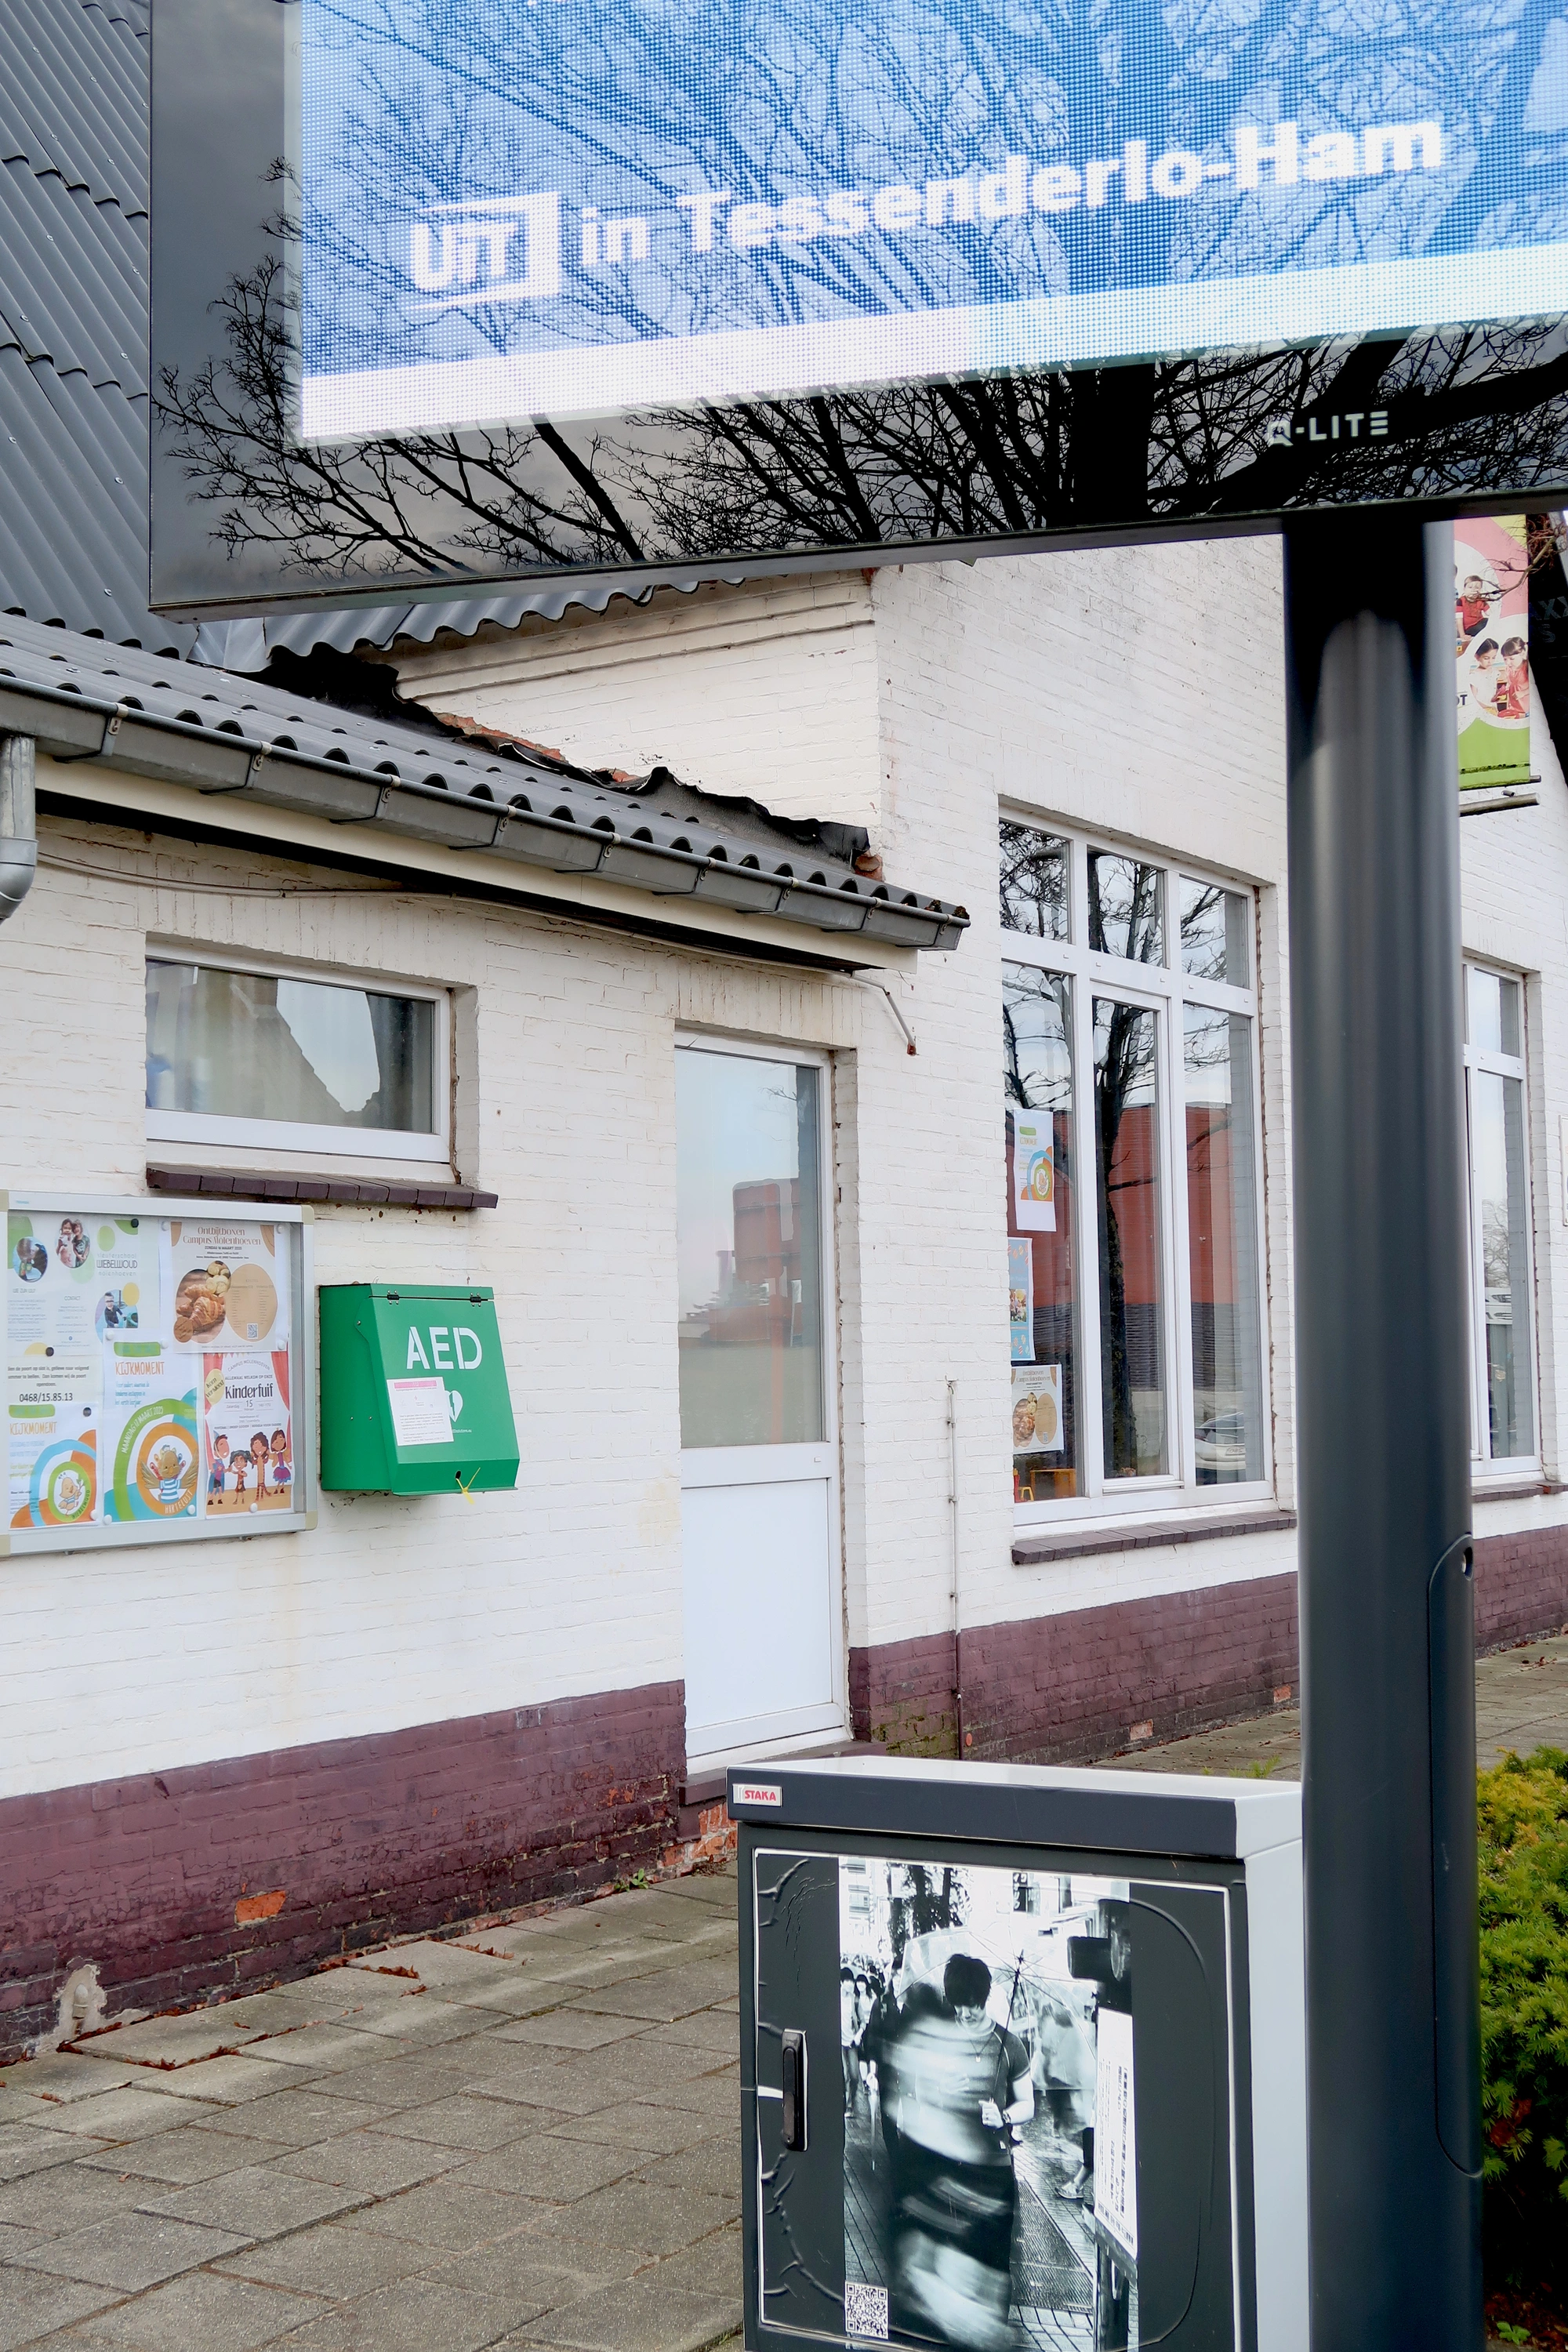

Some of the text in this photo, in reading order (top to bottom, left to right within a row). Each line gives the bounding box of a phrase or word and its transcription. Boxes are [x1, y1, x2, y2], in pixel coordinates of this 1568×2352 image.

[582, 205, 648, 265] in
[676, 119, 1443, 252] Tessenderlo-Ham
[198, 1226, 245, 1236] Ontbijtboxen
[183, 1236, 261, 1245] Campus Molenhoeven
[407, 1326, 483, 1370] AED
[114, 1361, 165, 1375] KIJKMOMENT
[227, 1359, 270, 1372] CAMPUS MOLENHOEVEN
[225, 1382, 274, 1399] Kinderfuif
[19, 1392, 73, 1403] 0468/15.85.13
[245, 1399, 253, 1408] 15
[9, 1421, 58, 1436] KIJKMOMENT
[122, 1424, 136, 1454] MAANDAG
[137, 1408, 153, 1424] MAART
[744, 1790, 776, 1801] STAKA
